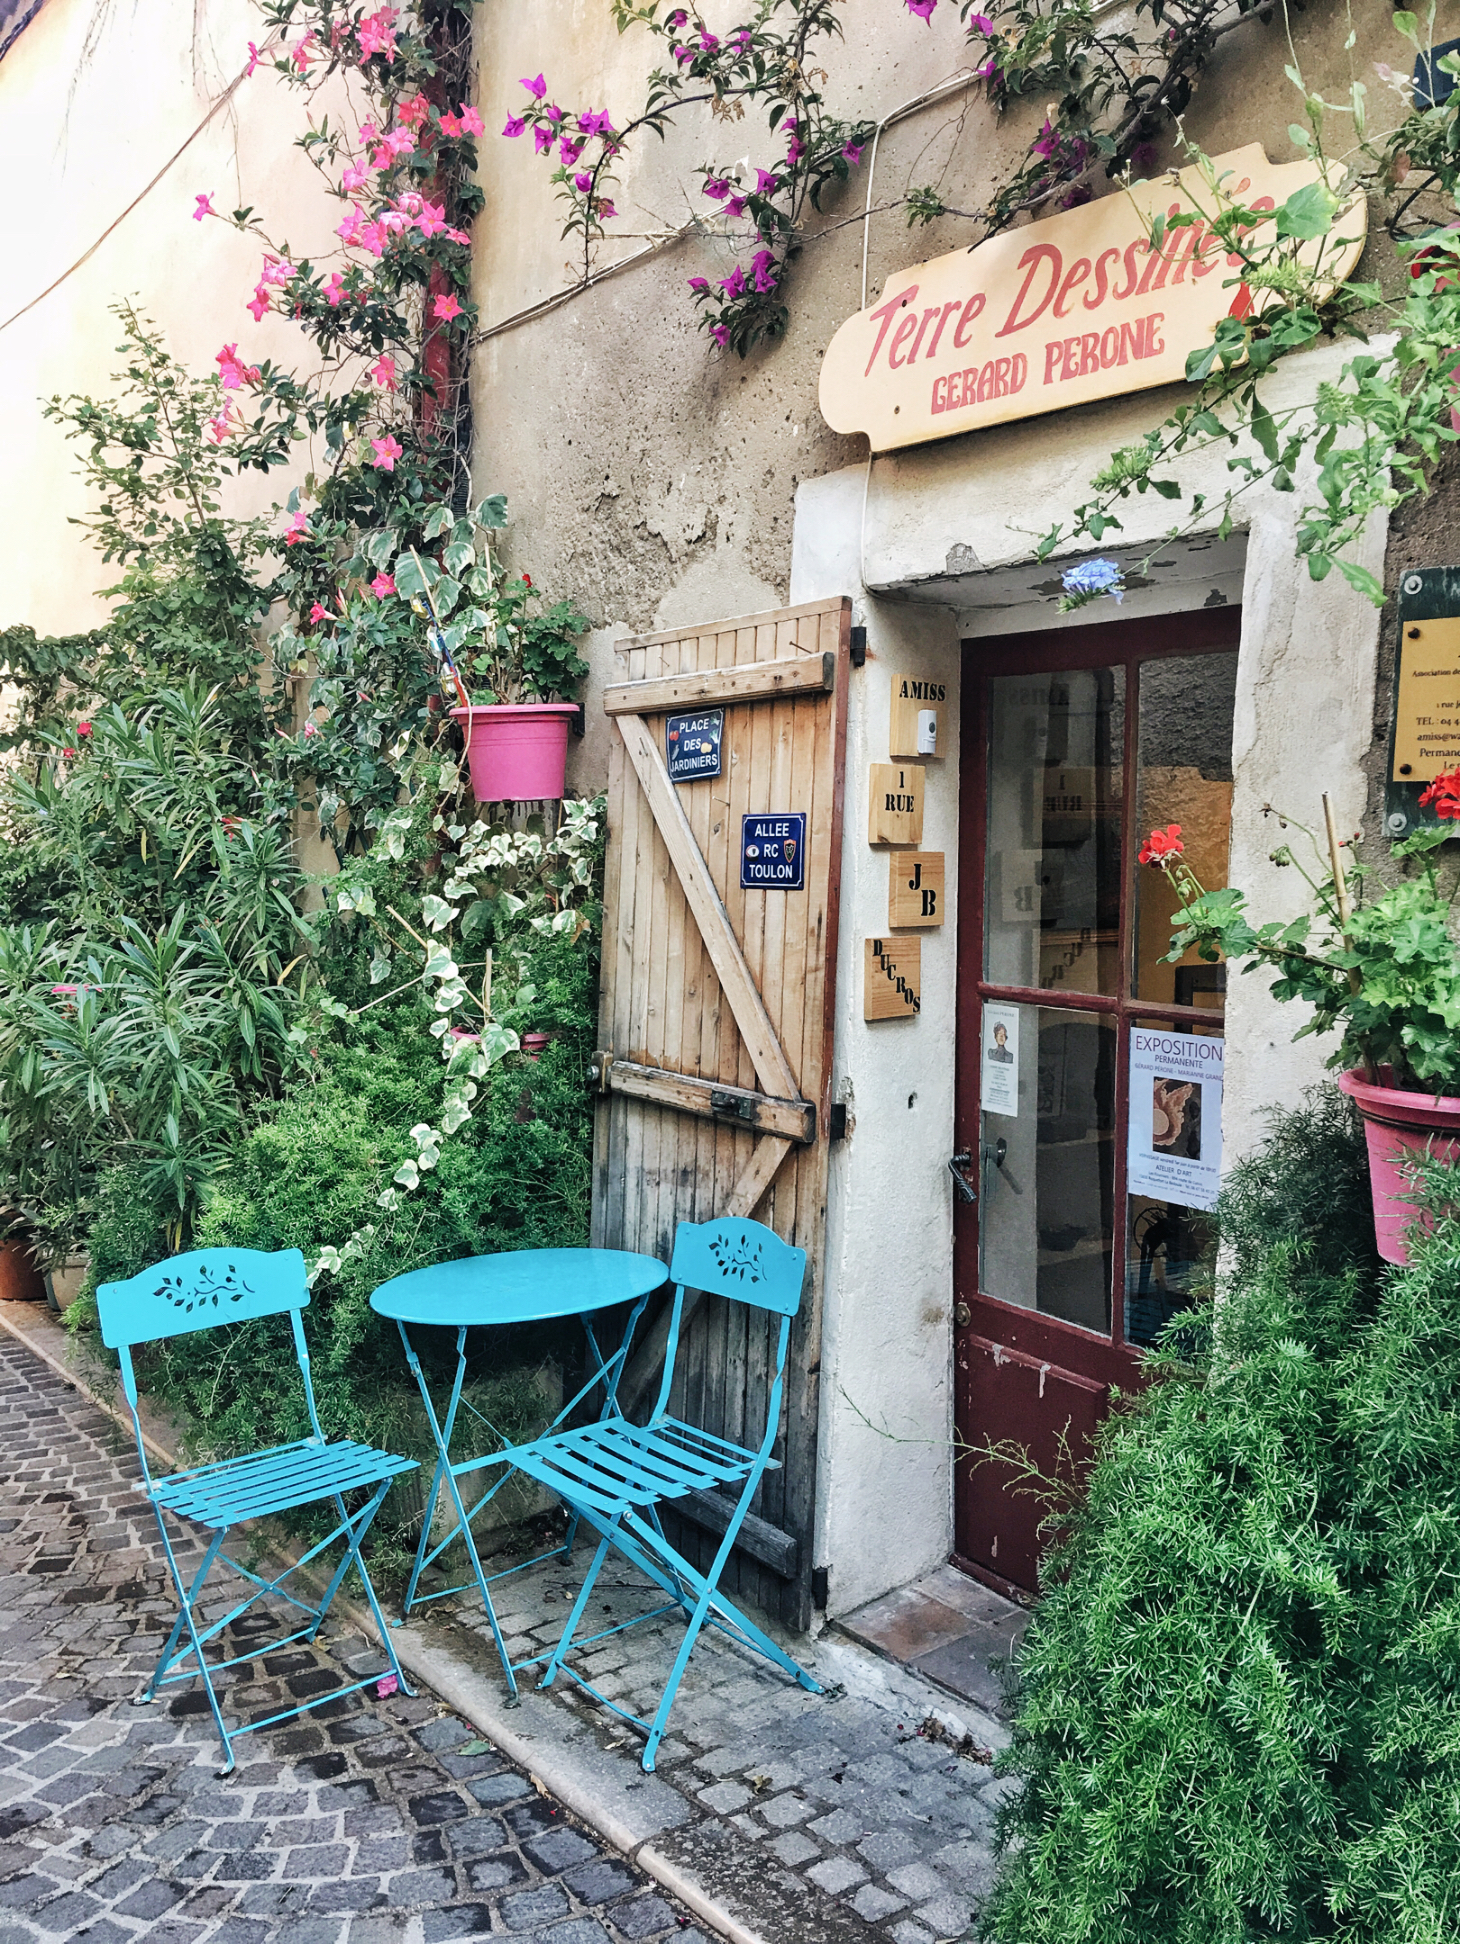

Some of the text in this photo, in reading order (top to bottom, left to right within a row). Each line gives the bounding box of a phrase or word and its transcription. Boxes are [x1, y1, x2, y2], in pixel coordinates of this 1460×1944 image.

[864, 284, 987, 378] Terre
[930, 313, 1166, 415] GERARD PERONE
[899, 680, 946, 702] AMISS
[678, 718, 709, 732] PLACE
[1416, 717, 1434, 726] TEL
[1440, 718, 1452, 726] 04
[684, 738, 702, 752] DES
[671, 753, 718, 774] JARDINIERS
[899, 771, 905, 788] 1
[885, 794, 914, 813] RUE
[754, 823, 790, 838] ALLEE
[764, 844, 779, 858] RC
[749, 864, 793, 880] TOULON
[1136, 1036, 1222, 1062] EXPOSITION
[1154, 1054, 1203, 1068] PERMANENTE
[1156, 1164, 1174, 1173] ATELIER
